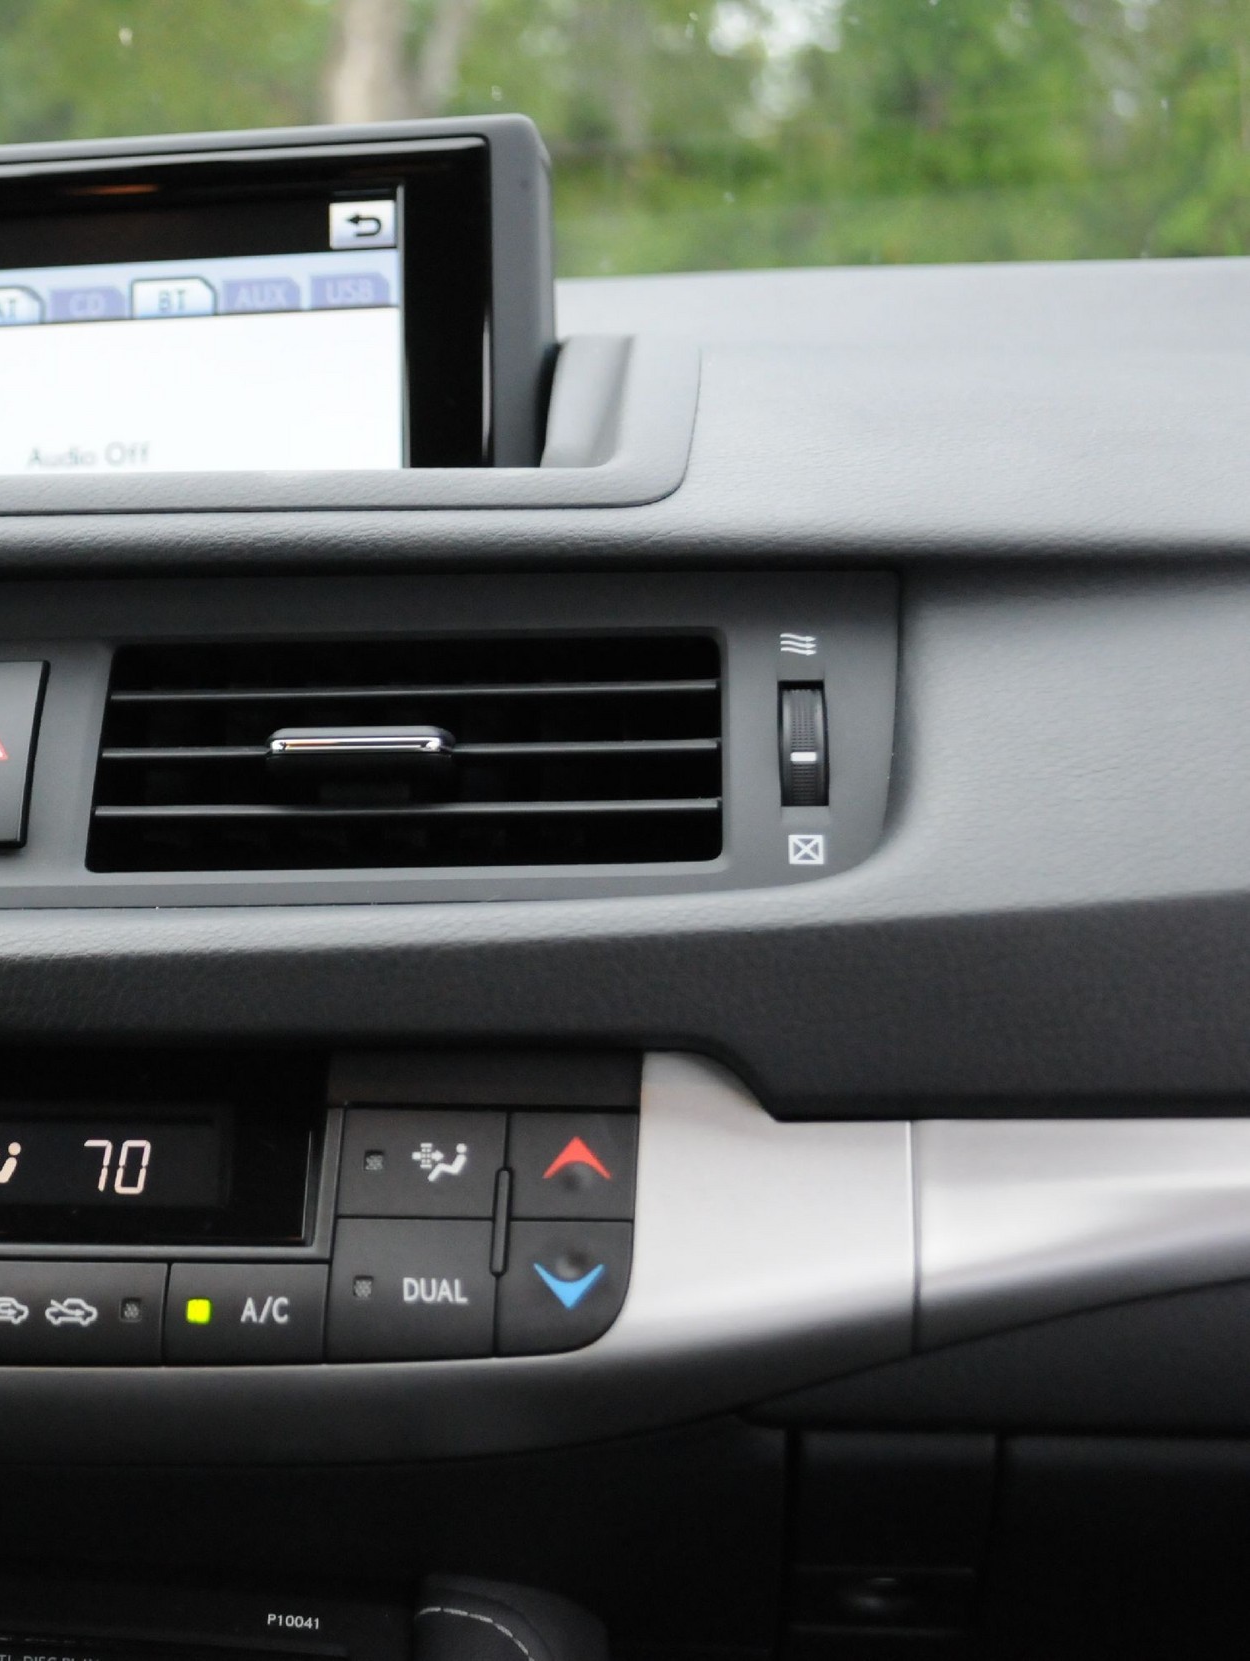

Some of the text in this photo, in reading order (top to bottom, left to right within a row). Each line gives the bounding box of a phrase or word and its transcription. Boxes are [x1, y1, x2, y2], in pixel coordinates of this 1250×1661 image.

[68, 293, 105, 315] CD
[158, 288, 187, 311] BT
[236, 284, 288, 310] AUX
[325, 278, 373, 304] USB
[27, 440, 150, 470] Audio Off
[83, 1139, 152, 1195] 70
[402, 1277, 468, 1303] DUAL
[240, 1296, 290, 1324] A/C
[266, 1613, 320, 1630] P10041
